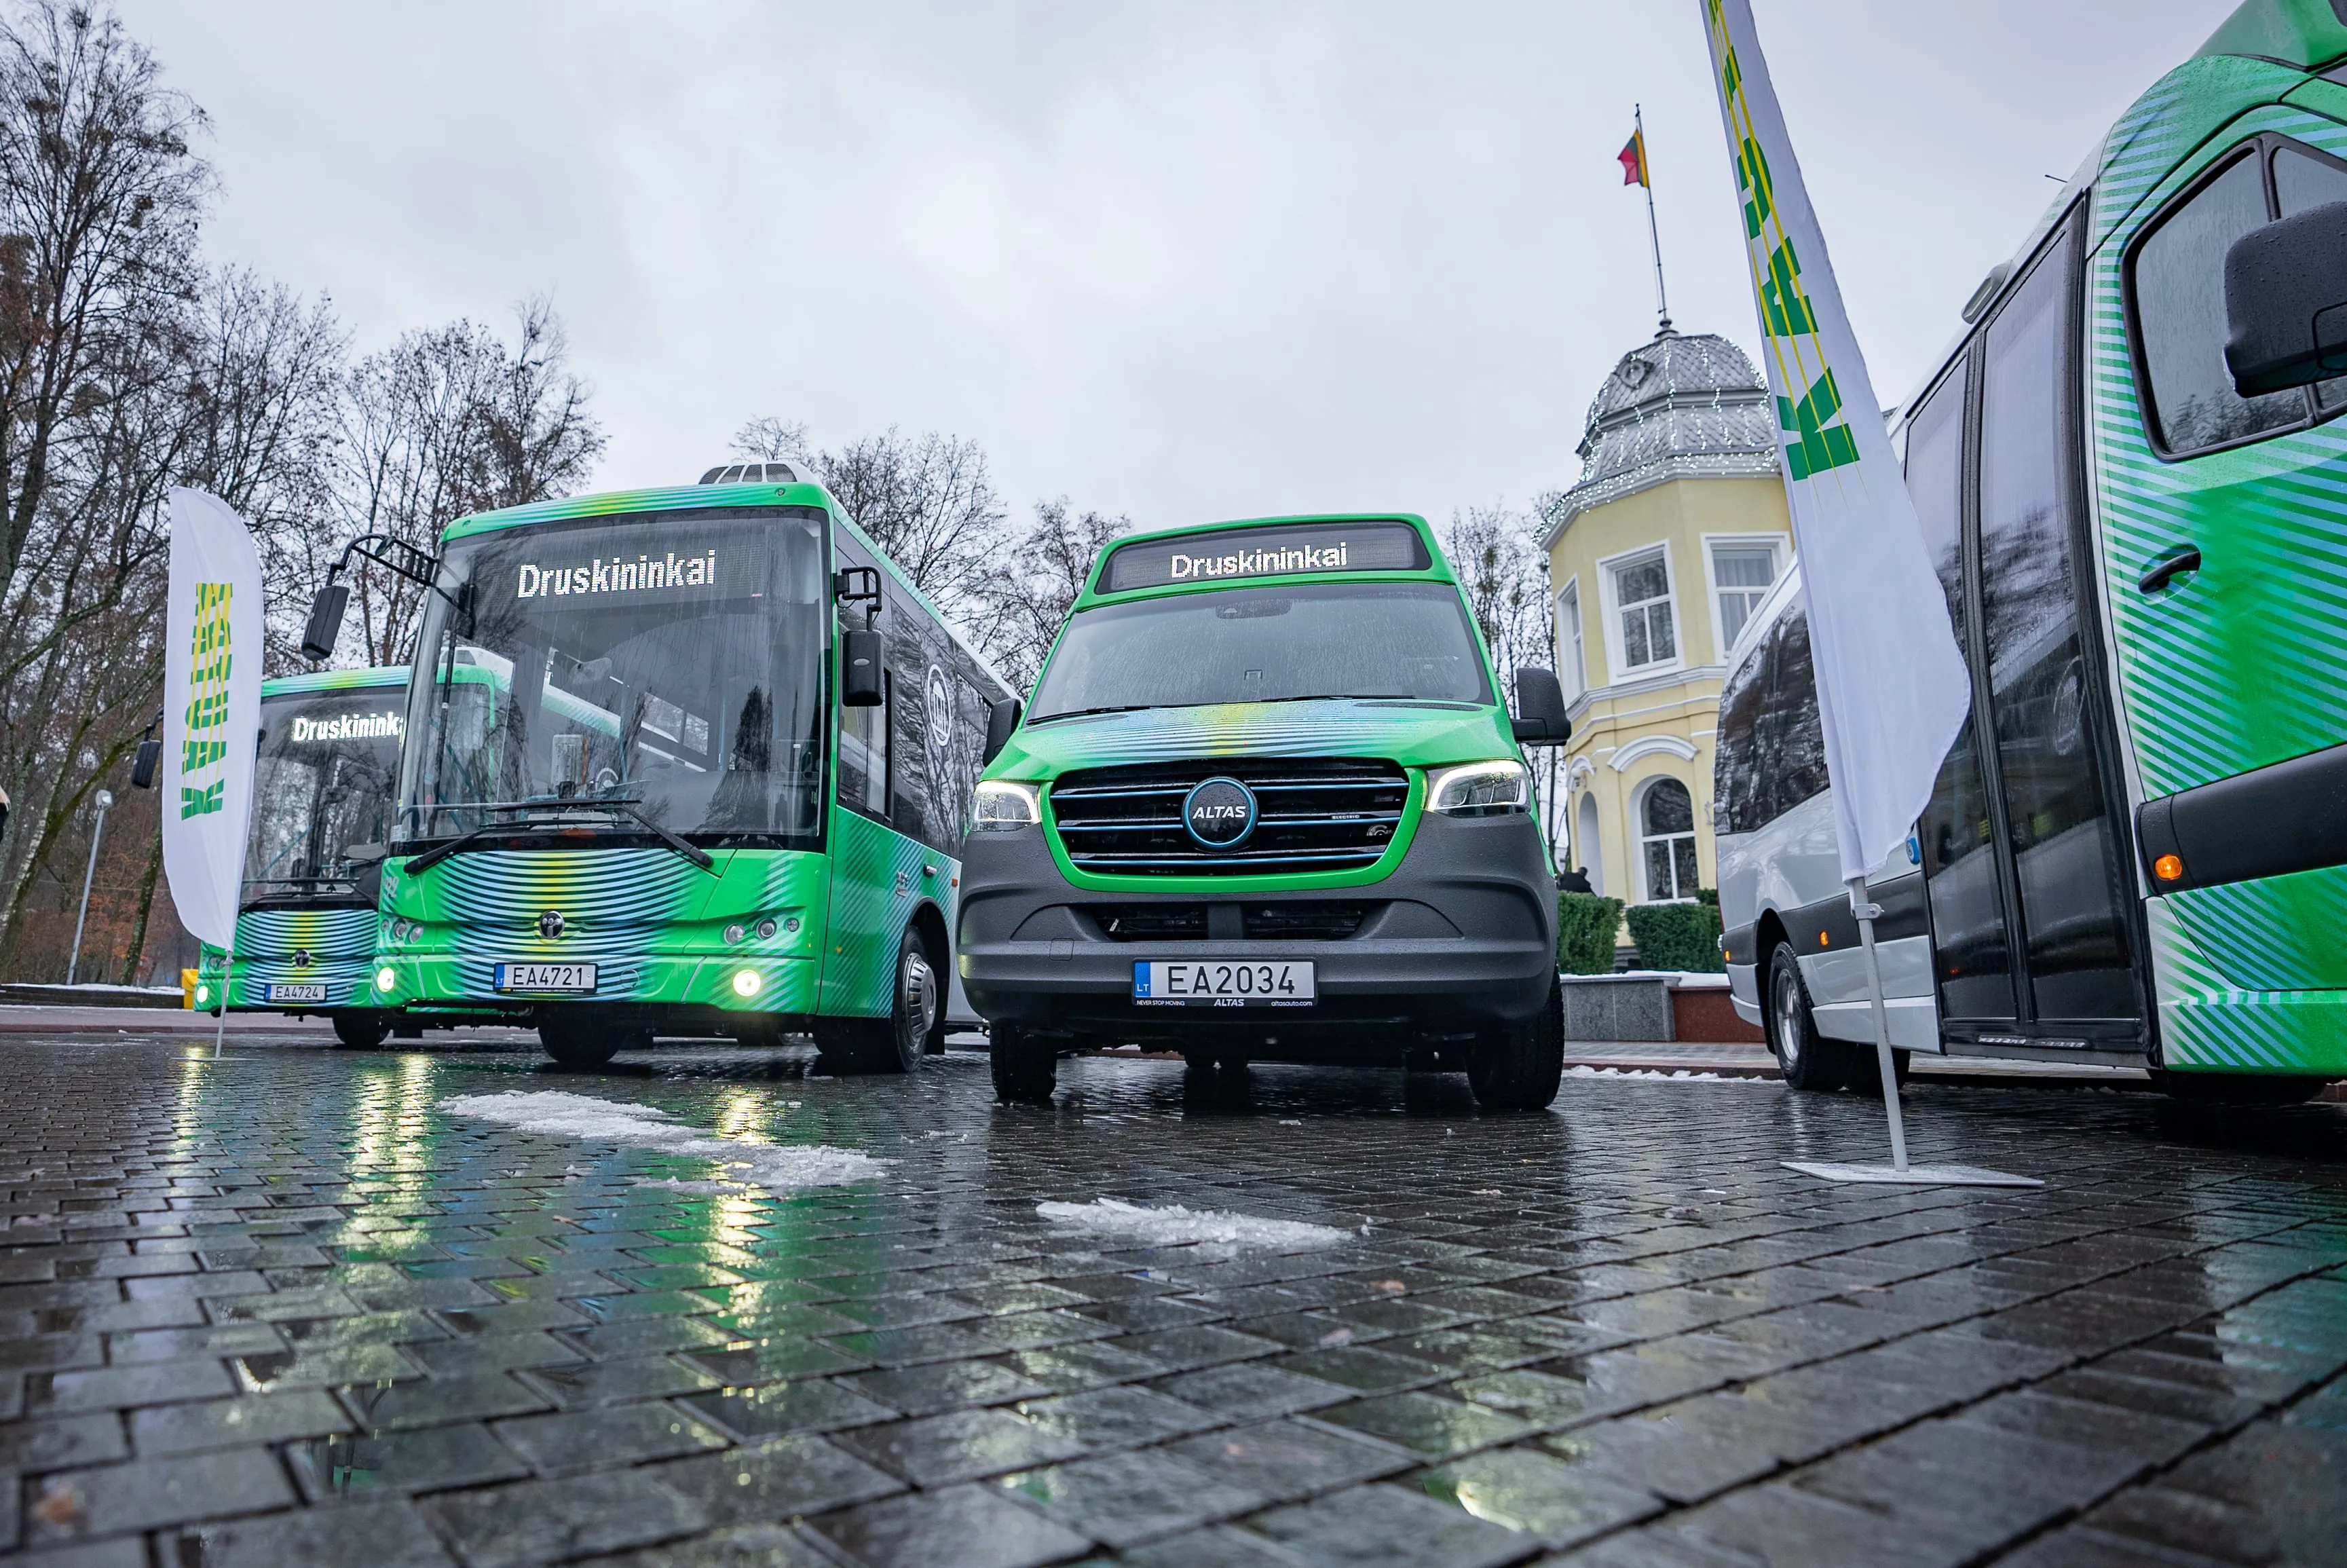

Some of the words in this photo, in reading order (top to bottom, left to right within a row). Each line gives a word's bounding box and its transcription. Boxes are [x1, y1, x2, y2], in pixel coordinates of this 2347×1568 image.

[1708, 0, 1860, 481] KAU
[1171, 541, 1348, 578] Druskininkai
[517, 548, 717, 599] Druskininkai
[1193, 806, 1246, 819] ALTAS
[512, 967, 582, 986] EA4721
[1136, 984, 1150, 992] LT
[1167, 965, 1295, 994] EA2034
[276, 986, 318, 998] EA4724
[1214, 998, 1245, 1007] ALTAS
